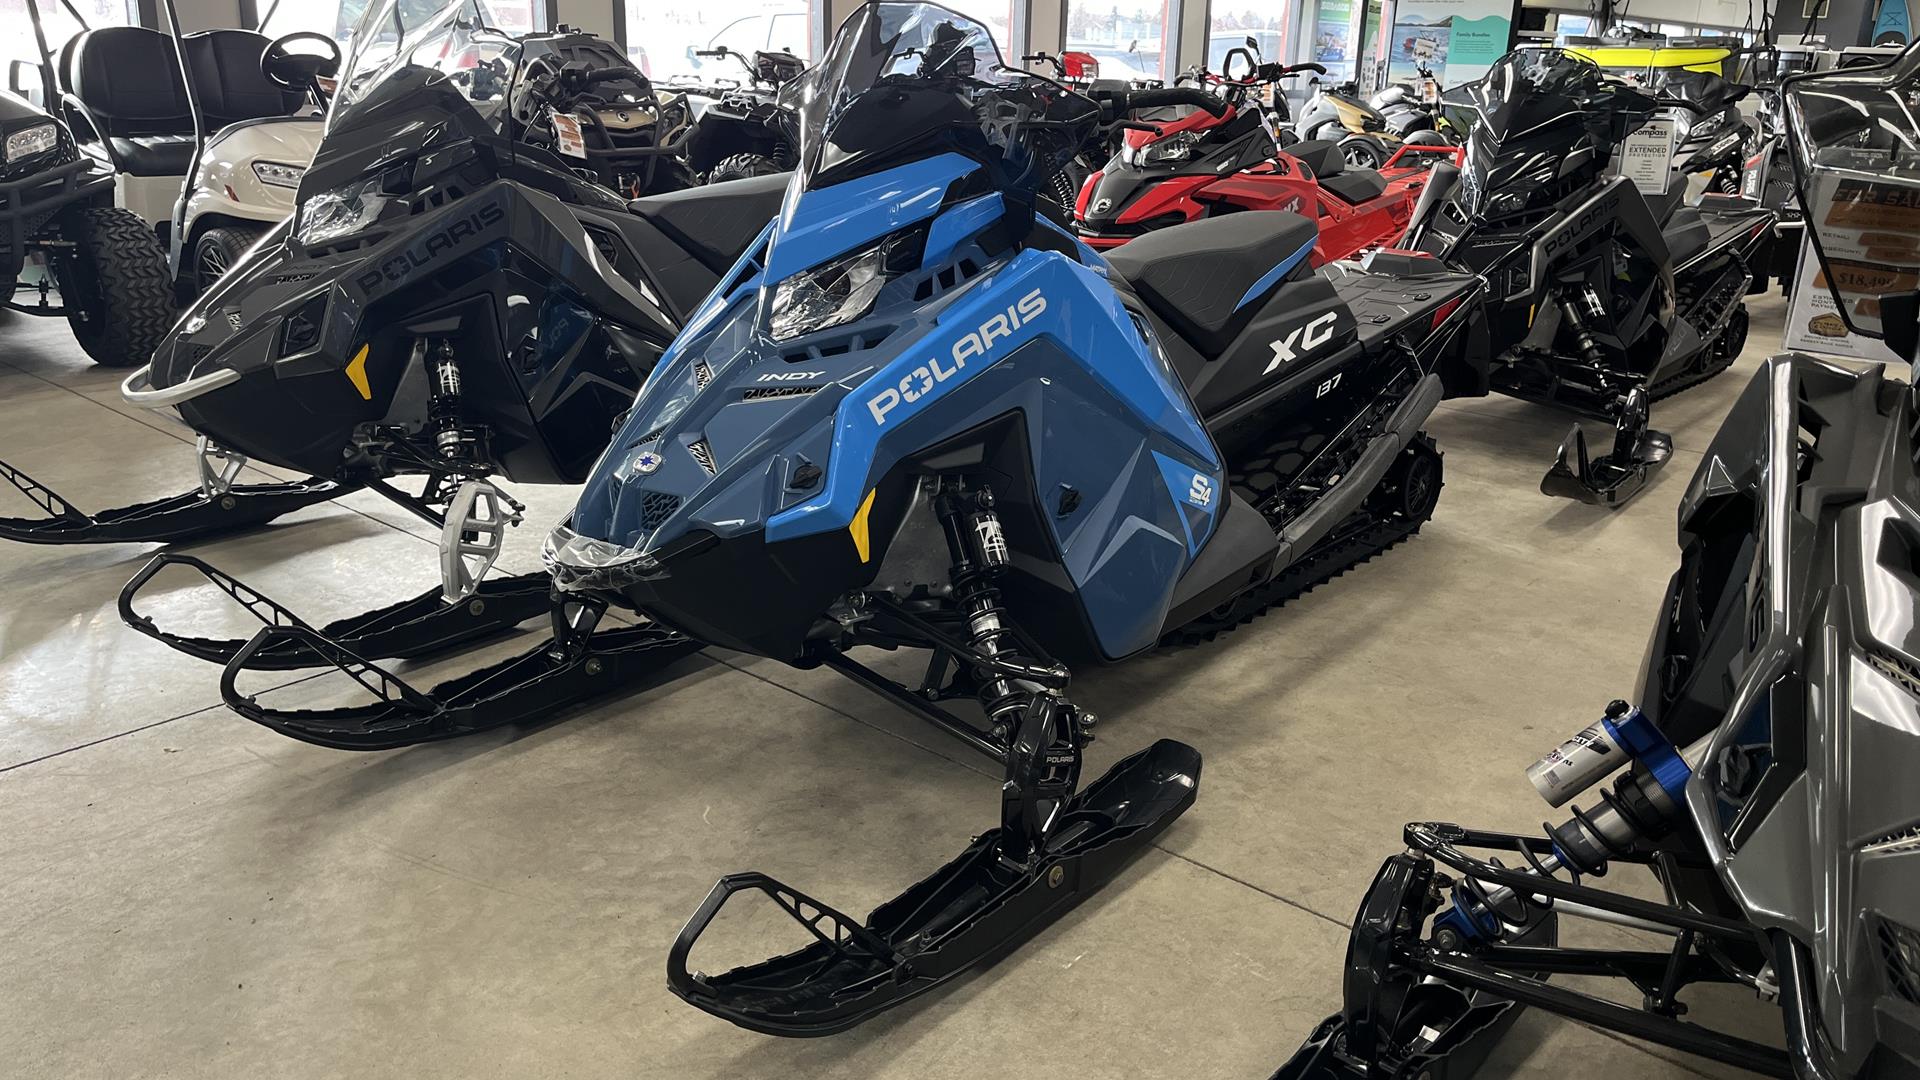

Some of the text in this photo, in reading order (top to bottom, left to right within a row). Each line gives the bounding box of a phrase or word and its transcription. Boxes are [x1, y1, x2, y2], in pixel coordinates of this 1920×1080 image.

[1629, 146, 1667, 154] EXTENDED
[1544, 198, 1619, 258] POLARIS
[356, 201, 505, 297] POLARIS
[867, 287, 1047, 426] POLARIS
[1262, 311, 1338, 376] XC
[756, 370, 827, 382] INDY
[1316, 372, 1342, 399] 137
[1189, 473, 1212, 506] S4
[1046, 756, 1075, 764] POLARIS
